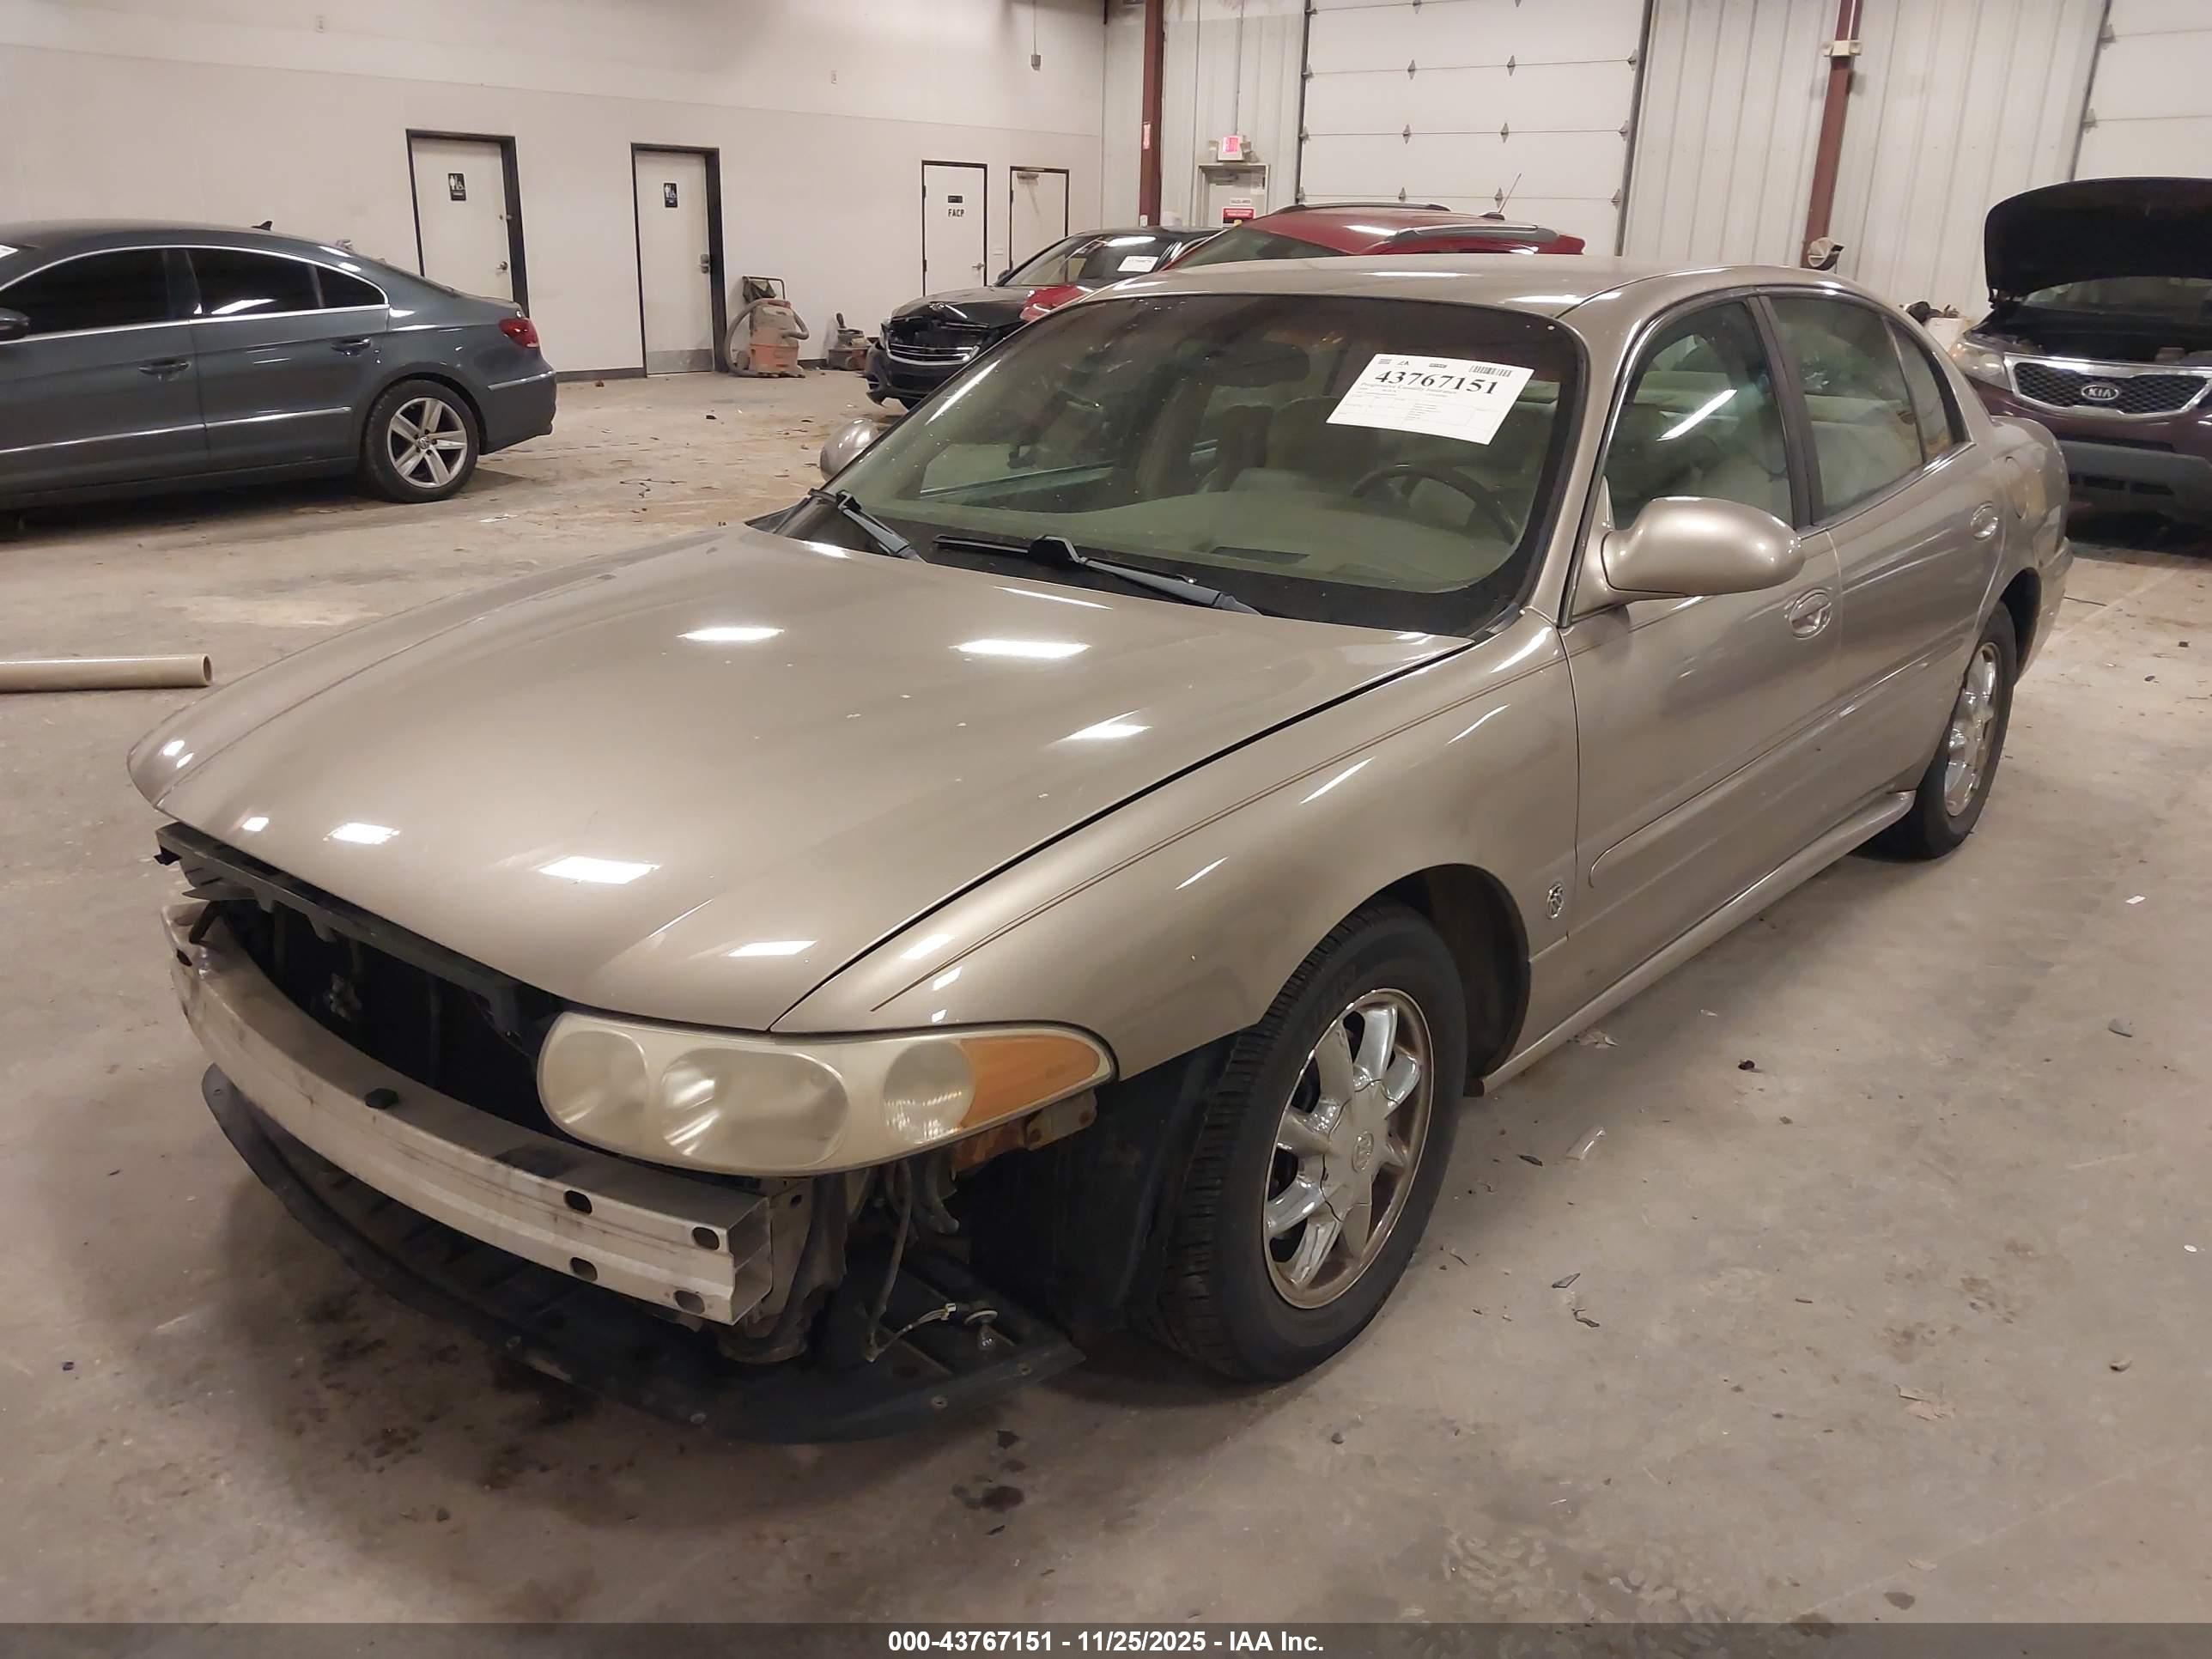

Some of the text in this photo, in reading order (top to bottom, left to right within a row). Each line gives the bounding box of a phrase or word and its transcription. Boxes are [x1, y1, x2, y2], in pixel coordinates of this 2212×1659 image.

[948, 208, 964, 217] FACP
[1375, 370, 1498, 394] 43767151
[2088, 387, 2112, 398] KIA
